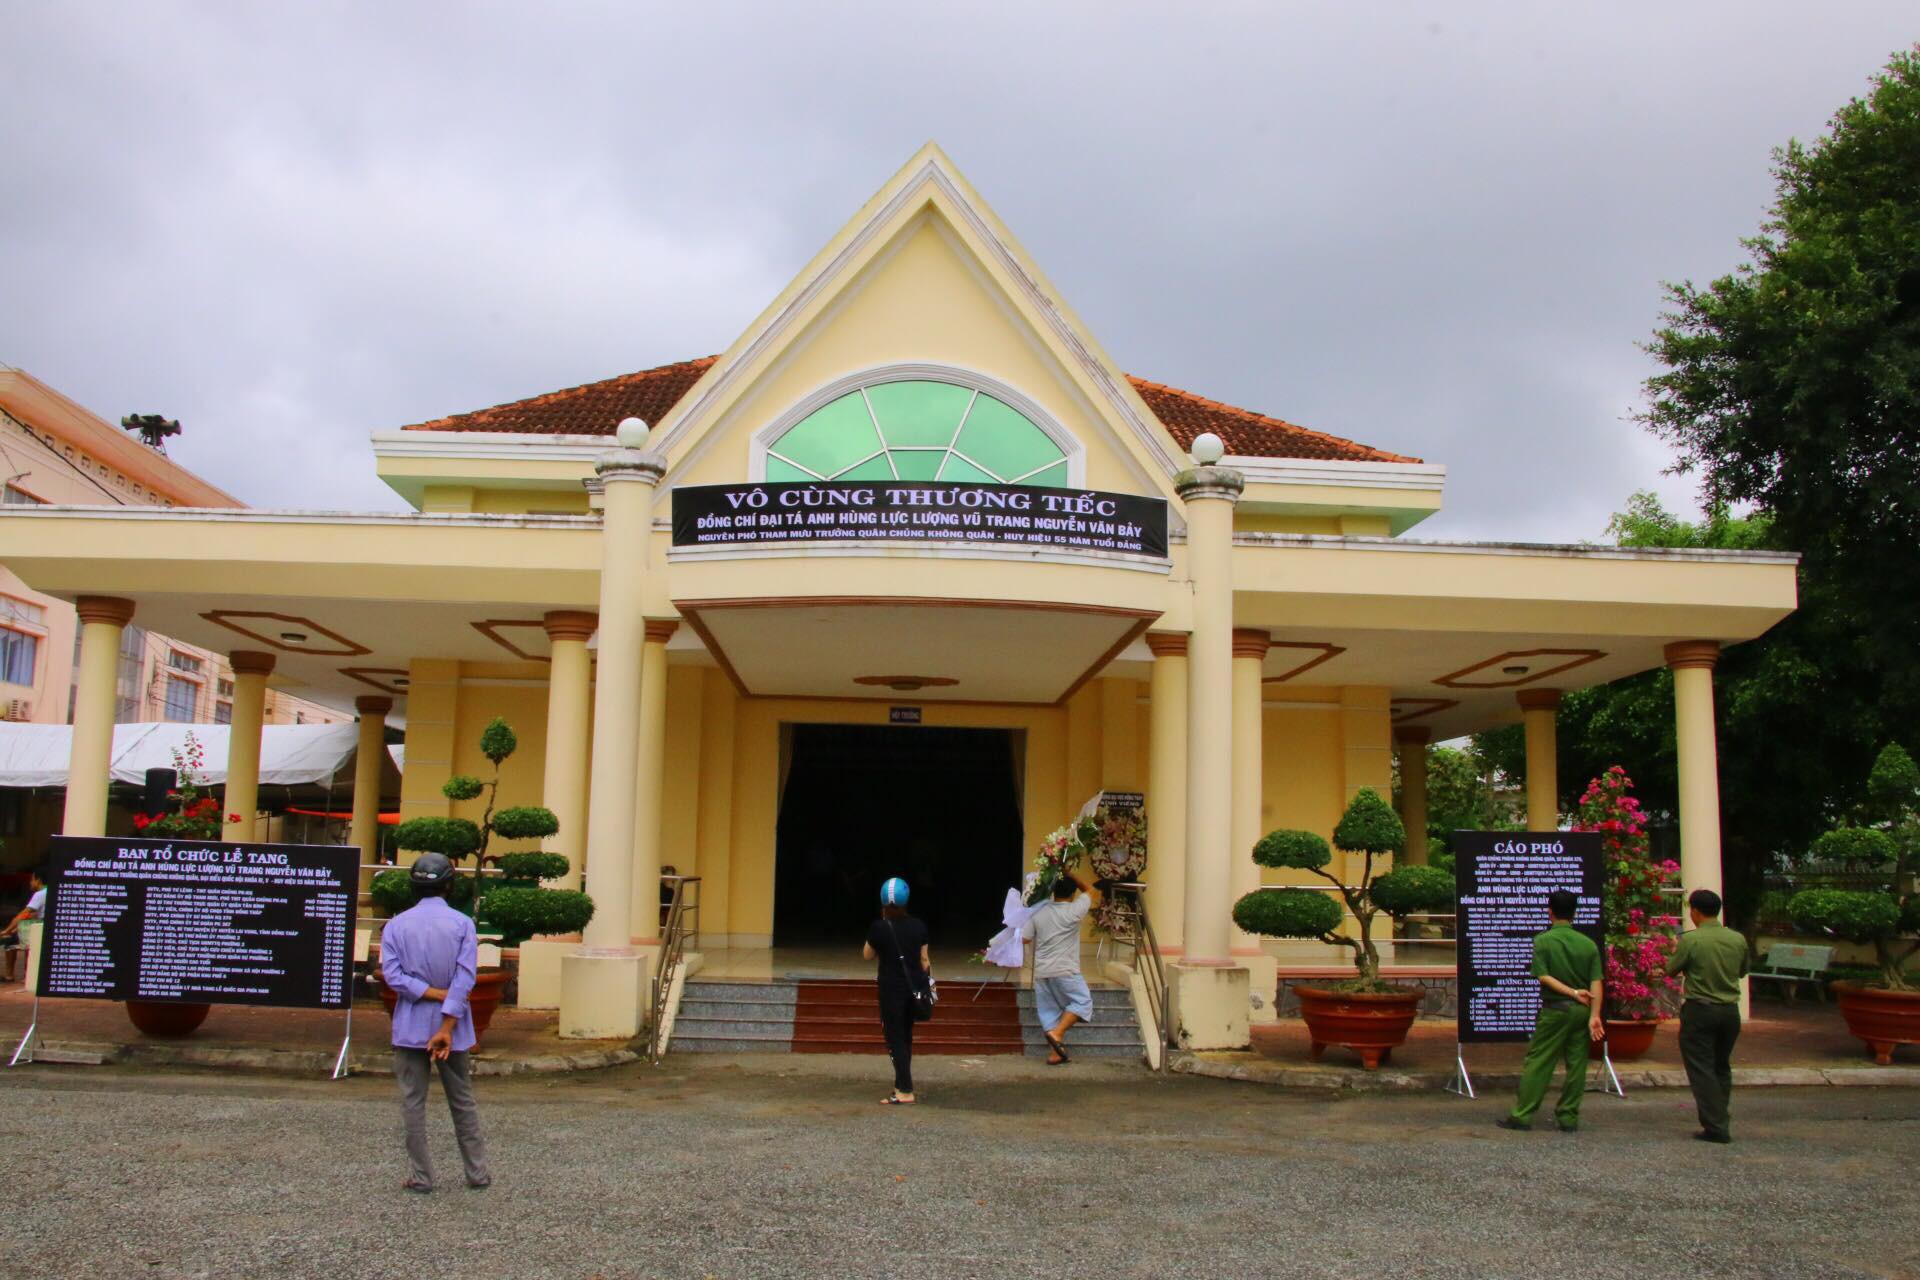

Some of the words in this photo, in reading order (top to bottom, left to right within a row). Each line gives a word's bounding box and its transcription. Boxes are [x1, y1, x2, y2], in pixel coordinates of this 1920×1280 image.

[724, 487, 769, 509] VÔ
[780, 485, 876, 506] CÙNG
[885, 487, 1032, 510] THƯƠNG
[1041, 492, 1116, 516] TIẾC
[697, 512, 732, 529] ĐỒNG
[734, 512, 757, 527] CHÍ
[760, 513, 782, 528] ĐẠI
[785, 510, 803, 525] TÁ
[807, 512, 835, 524] ANH
[839, 509, 877, 524] HÙNG
[881, 510, 909, 526] LỰC
[912, 511, 959, 526] LƯỢNG
[962, 511, 981, 526] VŨ
[985, 515, 1030, 528] TRANG
[1034, 515, 1086, 533] NGUYỄN
[1089, 520, 1115, 535] VĂN
[1117, 521, 1142, 538] BẢY
[697, 531, 735, 542] NGUYÊN
[737, 530, 757, 540] PHÓ
[760, 530, 787, 539] THAM
[789, 529, 812, 538] MƯU
[814, 528, 856, 537] TRƯỞNG
[858, 529, 887, 538] QUÂN
[889, 527, 925, 537] CHỦNG
[927, 529, 965, 538] KHÔNG
[966, 530, 995, 539] QUÂN
[1004, 532, 1024, 541] HUY
[1027, 533, 1051, 543] HIỆU
[1054, 535, 1067, 543] 55
[1069, 536, 1091, 545] NĂM
[1093, 537, 1115, 548] TUỔI
[1117, 539, 1142, 550] ĐẢNG
[118, 848, 148, 859] BAN
[153, 844, 173, 860] TỔ
[177, 848, 219, 862] CHỨC
[224, 847, 243, 862] LỄ
[248, 853, 288, 864] TANG
[1494, 840, 1527, 854] CÁO
[1530, 841, 1564, 854] PHÓ
